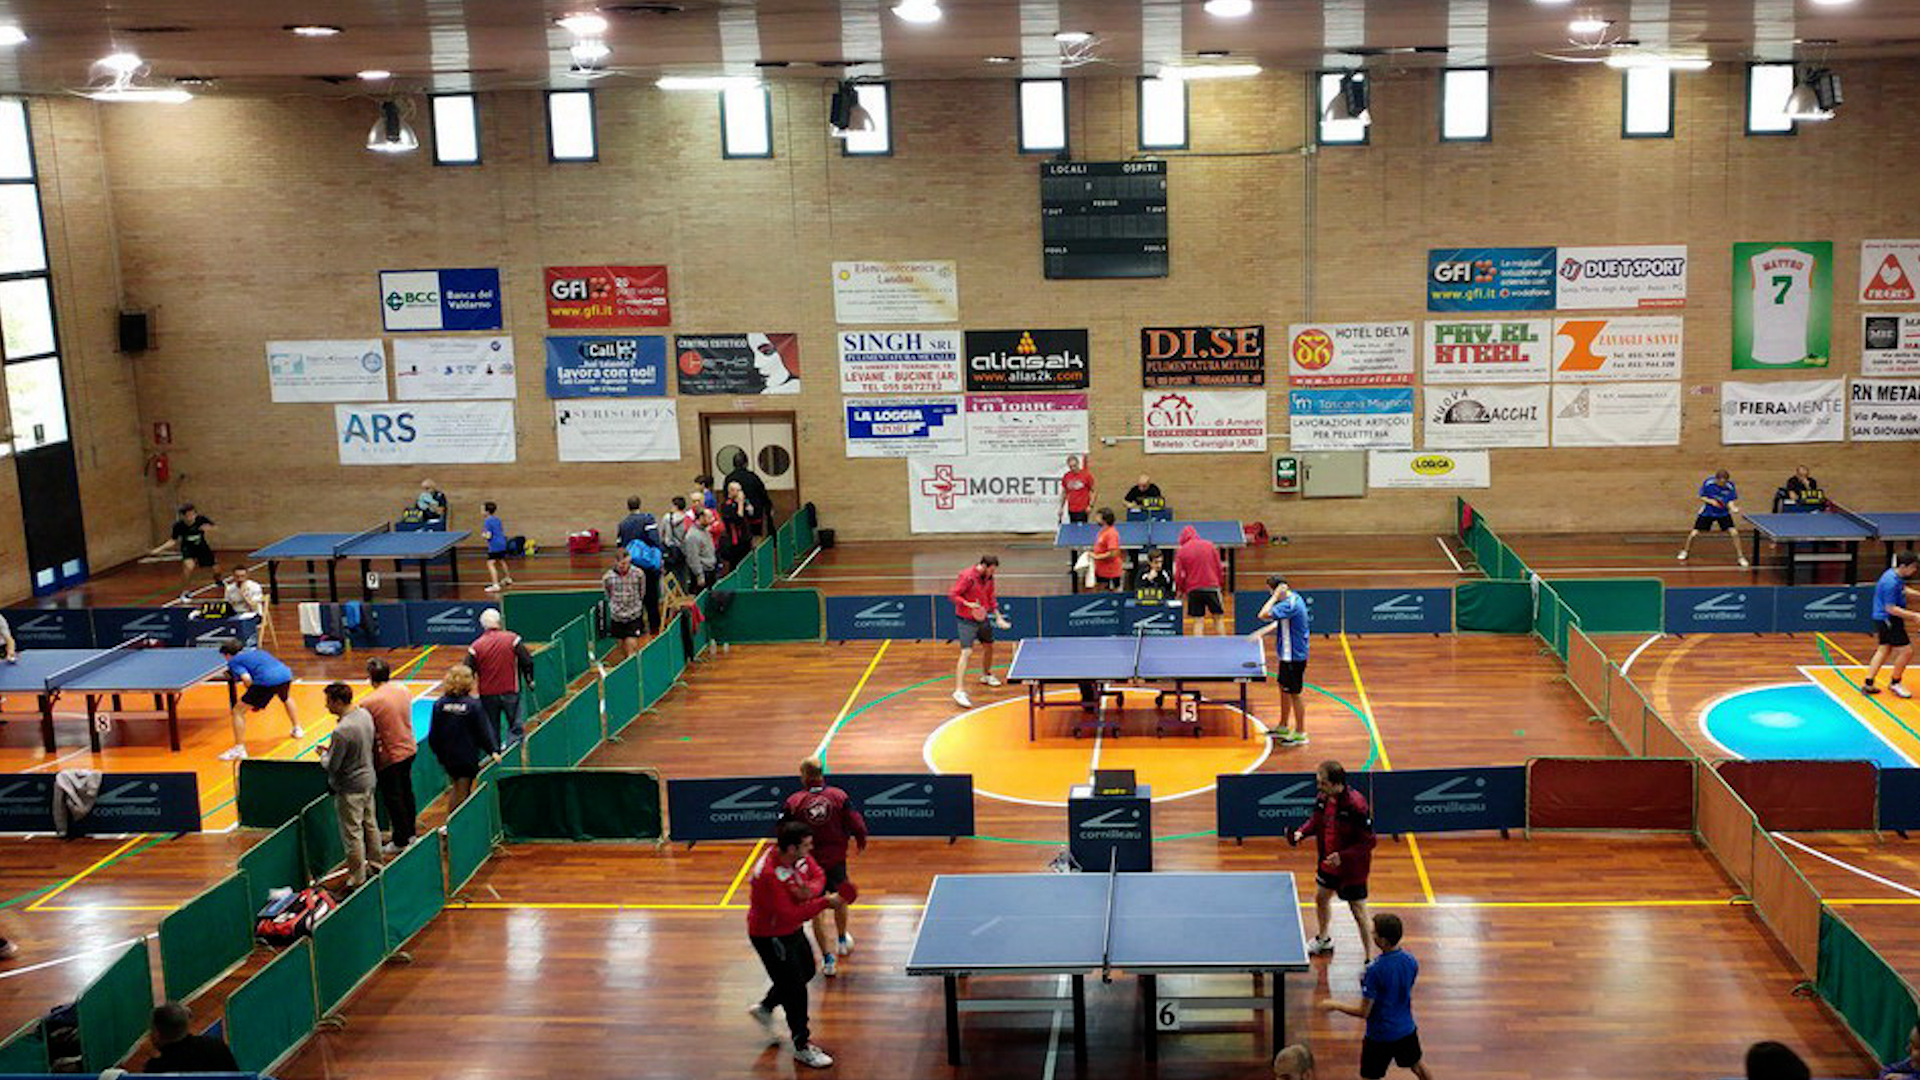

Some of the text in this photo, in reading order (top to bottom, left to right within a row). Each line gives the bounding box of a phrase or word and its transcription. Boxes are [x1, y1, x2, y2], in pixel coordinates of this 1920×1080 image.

[1050, 165, 1088, 174] LOCALI
[1122, 163, 1158, 173] OSPITI
[1764, 260, 1804, 271] MATTEO
[1434, 263, 1472, 283] GFI
[447, 290, 493, 300] Banca del
[552, 280, 588, 300] GFI
[1431, 288, 1496, 302] www.gfi.it
[1512, 289, 1551, 297] vodafone
[1772, 276, 1792, 304] 7
[405, 292, 437, 303] BCC
[447, 301, 493, 310] Valdarno
[550, 304, 612, 319] www.gfi.it
[1335, 325, 1409, 339] HOTEL DELTA
[678, 339, 747, 348] CENTRO ESTETICO
[845, 332, 955, 351] SINGH SRL
[1146, 328, 1262, 358] DI.SE
[1600, 334, 1679, 345] ZAVAGLI SANTI
[590, 344, 616, 357] Call
[558, 365, 656, 380] lavora con noi!
[845, 372, 885, 382] LEVANE
[895, 371, 933, 381] BUCINE
[937, 371, 957, 381] (AR)
[972, 371, 1083, 383] www.alias2k.com
[1852, 384, 1871, 400] RN
[972, 403, 994, 411] LA
[1001, 403, 1054, 411] TORRE
[1320, 399, 1362, 410] Toscana
[1432, 389, 1469, 424] NUOVA
[1740, 398, 1841, 415] FIERAMENTE
[573, 409, 674, 419] SERISCREEN
[854, 411, 872, 421] LA
[874, 409, 924, 421] LOGGIA
[1147, 410, 1199, 427] CMV
[1853, 411, 1868, 420] Via
[344, 412, 417, 443] ARS
[1294, 416, 1410, 428] LAVORAZIONE ARTICOLI
[876, 424, 909, 434] SPORT
[1313, 430, 1389, 439] PER PELLETTERIA
[1851, 427, 1870, 436] SAN
[1152, 440, 1183, 448] Meleto
[1193, 440, 1234, 450] Cavriglia
[1236, 439, 1259, 448] (AR)
[1416, 460, 1449, 468] LOGICA
[970, 477, 1063, 494] MORETT
[369, 573, 377, 585] 9
[1372, 612, 1425, 621] cornilleau
[1693, 612, 1747, 621] cornilleau
[1803, 611, 1856, 620] cornilleau
[854, 618, 906, 628] cornilleau
[1069, 618, 1120, 627] cornilleau
[427, 625, 476, 633] cornilleau
[1184, 701, 1194, 720] 5
[98, 715, 108, 731] 8
[0, 803, 50, 816] rnilleau
[92, 805, 162, 817] cornilleau
[864, 806, 935, 818] cornilleau
[1258, 806, 1312, 818] cornille
[1413, 799, 1487, 816] cornilleau
[1079, 829, 1142, 840] cornilleau
[1160, 1002, 1175, 1026] 6
